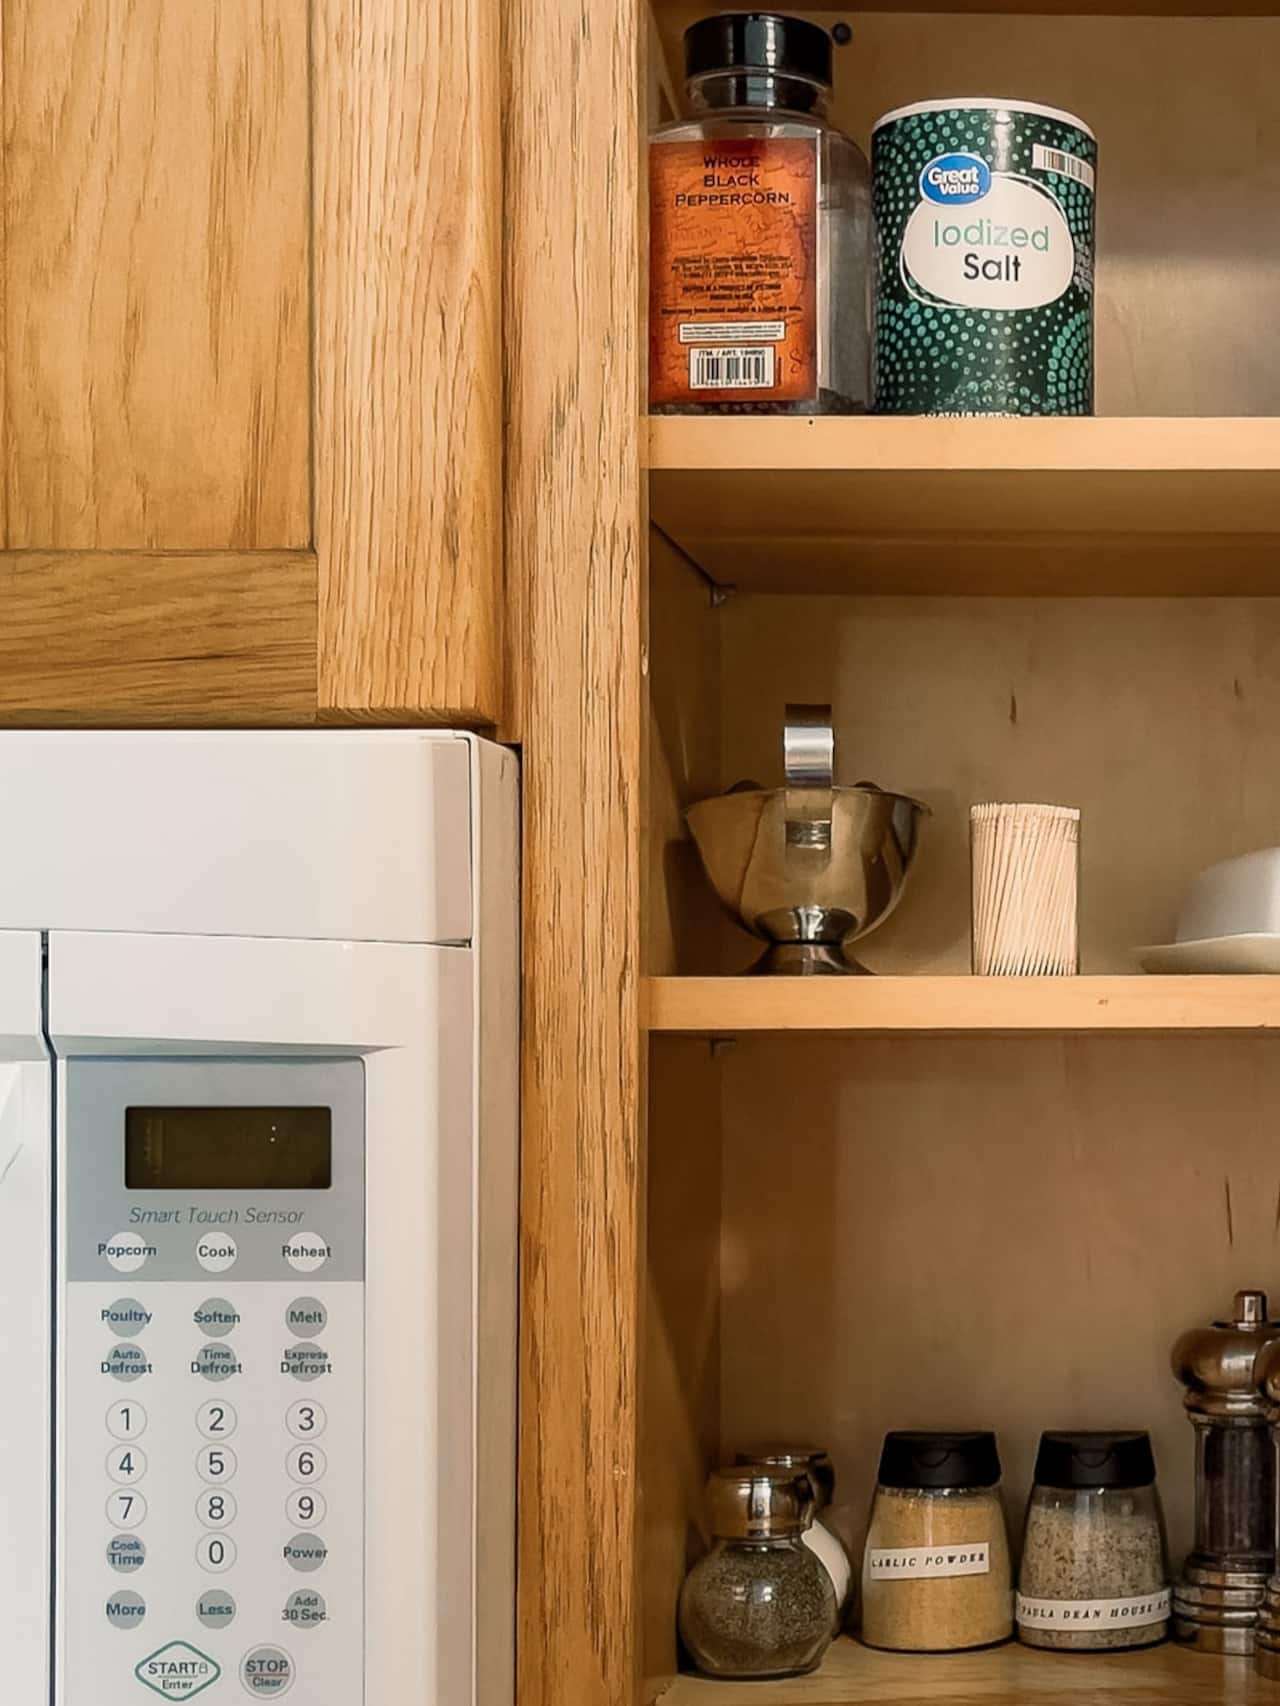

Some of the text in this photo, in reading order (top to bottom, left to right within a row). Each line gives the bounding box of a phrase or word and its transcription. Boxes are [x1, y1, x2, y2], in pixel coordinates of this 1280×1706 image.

[704, 156, 760, 168] WHOLE
[704, 175, 760, 187] BLACK
[928, 167, 979, 185] Great
[940, 183, 980, 195] Value
[675, 192, 790, 206] PEPPERCORN
[934, 219, 1050, 252] Iodized
[963, 253, 1022, 282] Salt
[129, 1207, 305, 1224] Smart Touch Sensor
[98, 1244, 157, 1257] Popcorn
[199, 1245, 235, 1257] Cook
[282, 1245, 331, 1257] Reheat
[101, 1310, 152, 1324] Poultry
[193, 1311, 240, 1323] Soften
[290, 1311, 322, 1323] Melt
[113, 1350, 140, 1360] Auto
[203, 1350, 231, 1360] Time
[284, 1350, 328, 1362] Express
[101, 1362, 153, 1374] Defrost
[191, 1362, 243, 1374] Defrost
[280, 1362, 332, 1374] Defrost
[120, 1408, 131, 1431] 1
[208, 1407, 225, 1431] 2
[298, 1407, 315, 1431] 3
[119, 1452, 135, 1475] 4
[208, 1452, 225, 1476] 5
[298, 1452, 315, 1476] 6
[118, 1496, 135, 1520] 7
[208, 1496, 225, 1520] 8
[297, 1496, 315, 1520] 9
[111, 1541, 141, 1552] Cook
[208, 1540, 225, 1564] 0
[283, 1546, 328, 1560] Power
[110, 1553, 145, 1566] Time
[294, 1597, 318, 1607] Add
[106, 1604, 146, 1617] More
[199, 1604, 233, 1616] Less
[281, 1609, 301, 1621] 30
[1110, 1603, 1152, 1618] HOUSE
[148, 1662, 199, 1676] START
[246, 1659, 288, 1673] STOP
[162, 1679, 193, 1690] Enter
[252, 1676, 283, 1689] Clear
